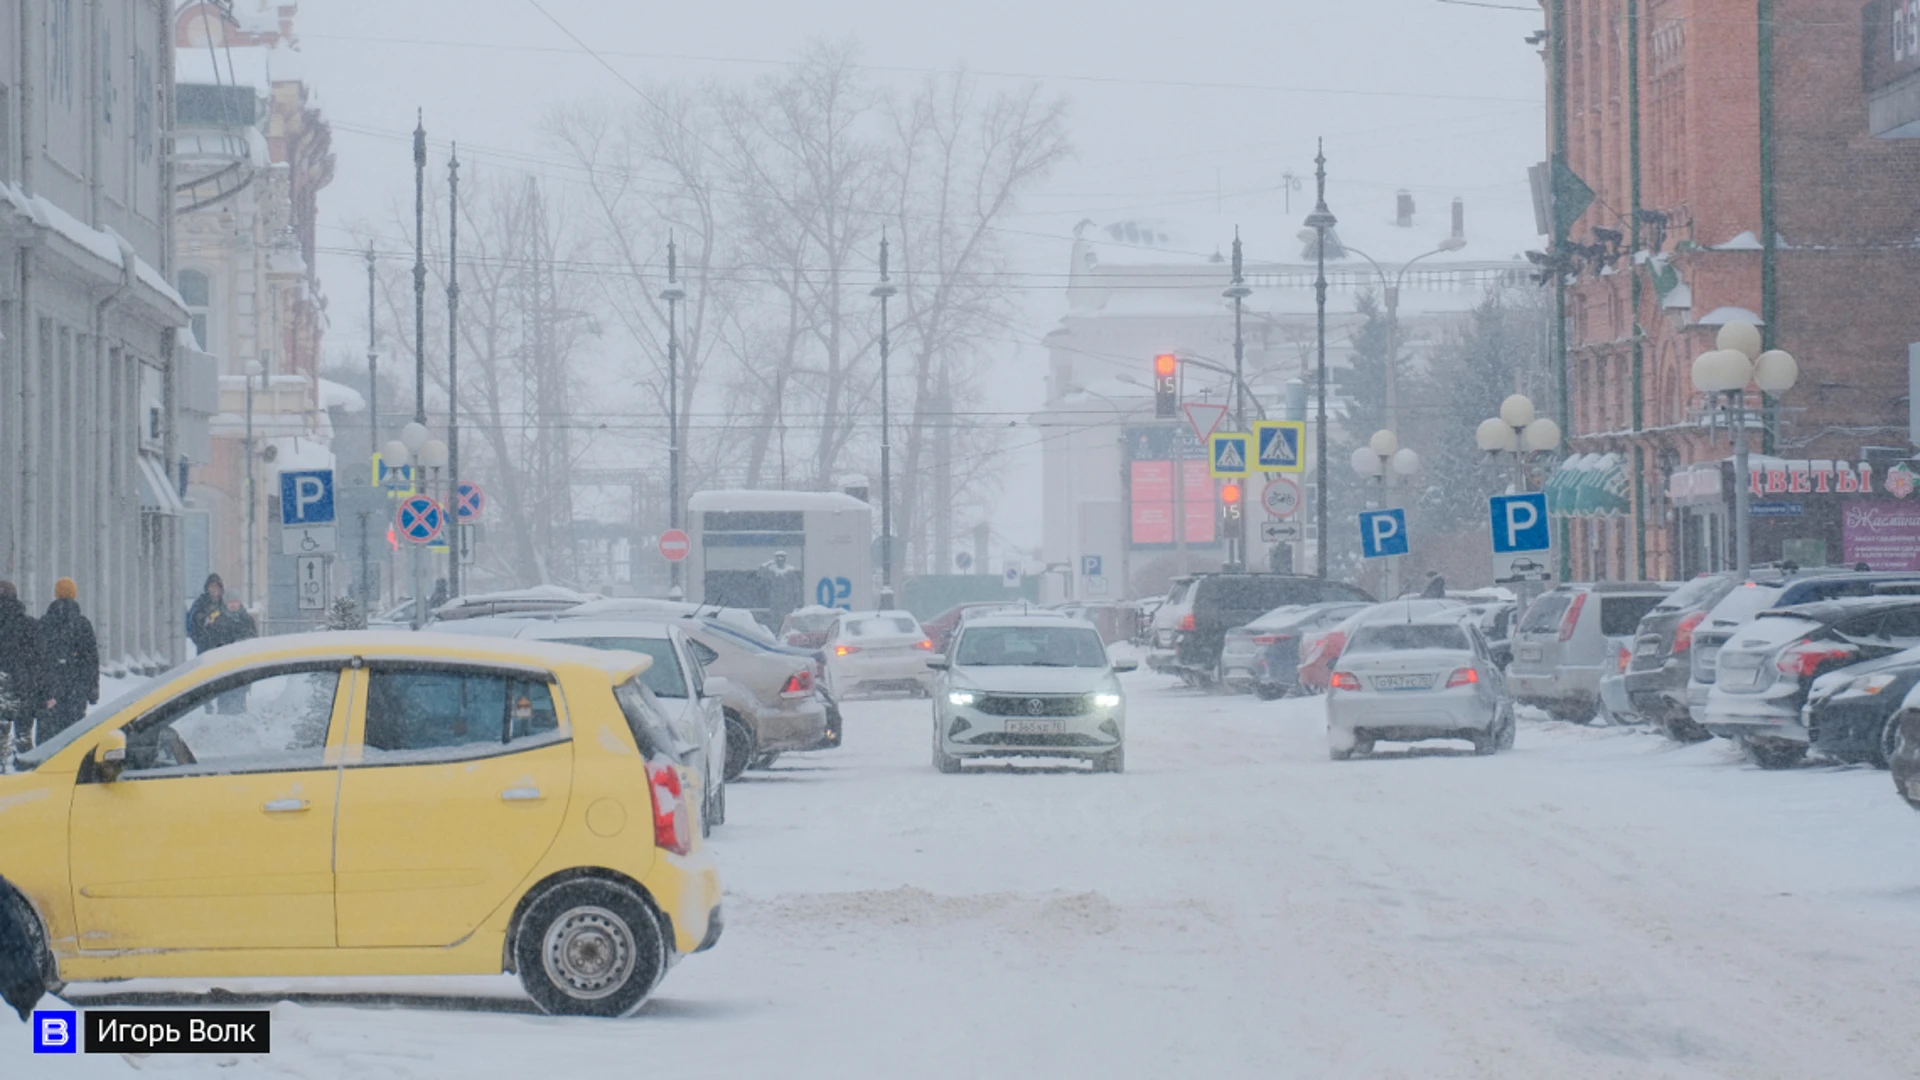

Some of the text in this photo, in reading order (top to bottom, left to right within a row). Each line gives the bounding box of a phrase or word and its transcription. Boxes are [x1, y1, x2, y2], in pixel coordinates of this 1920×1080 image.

[1157, 376, 1175, 393] 15
[295, 476, 325, 520] P
[1222, 504, 1240, 519] 15
[1371, 514, 1398, 552] P
[1505, 501, 1538, 547] P
[1085, 558, 1098, 574] P
[816, 576, 852, 612] 02
